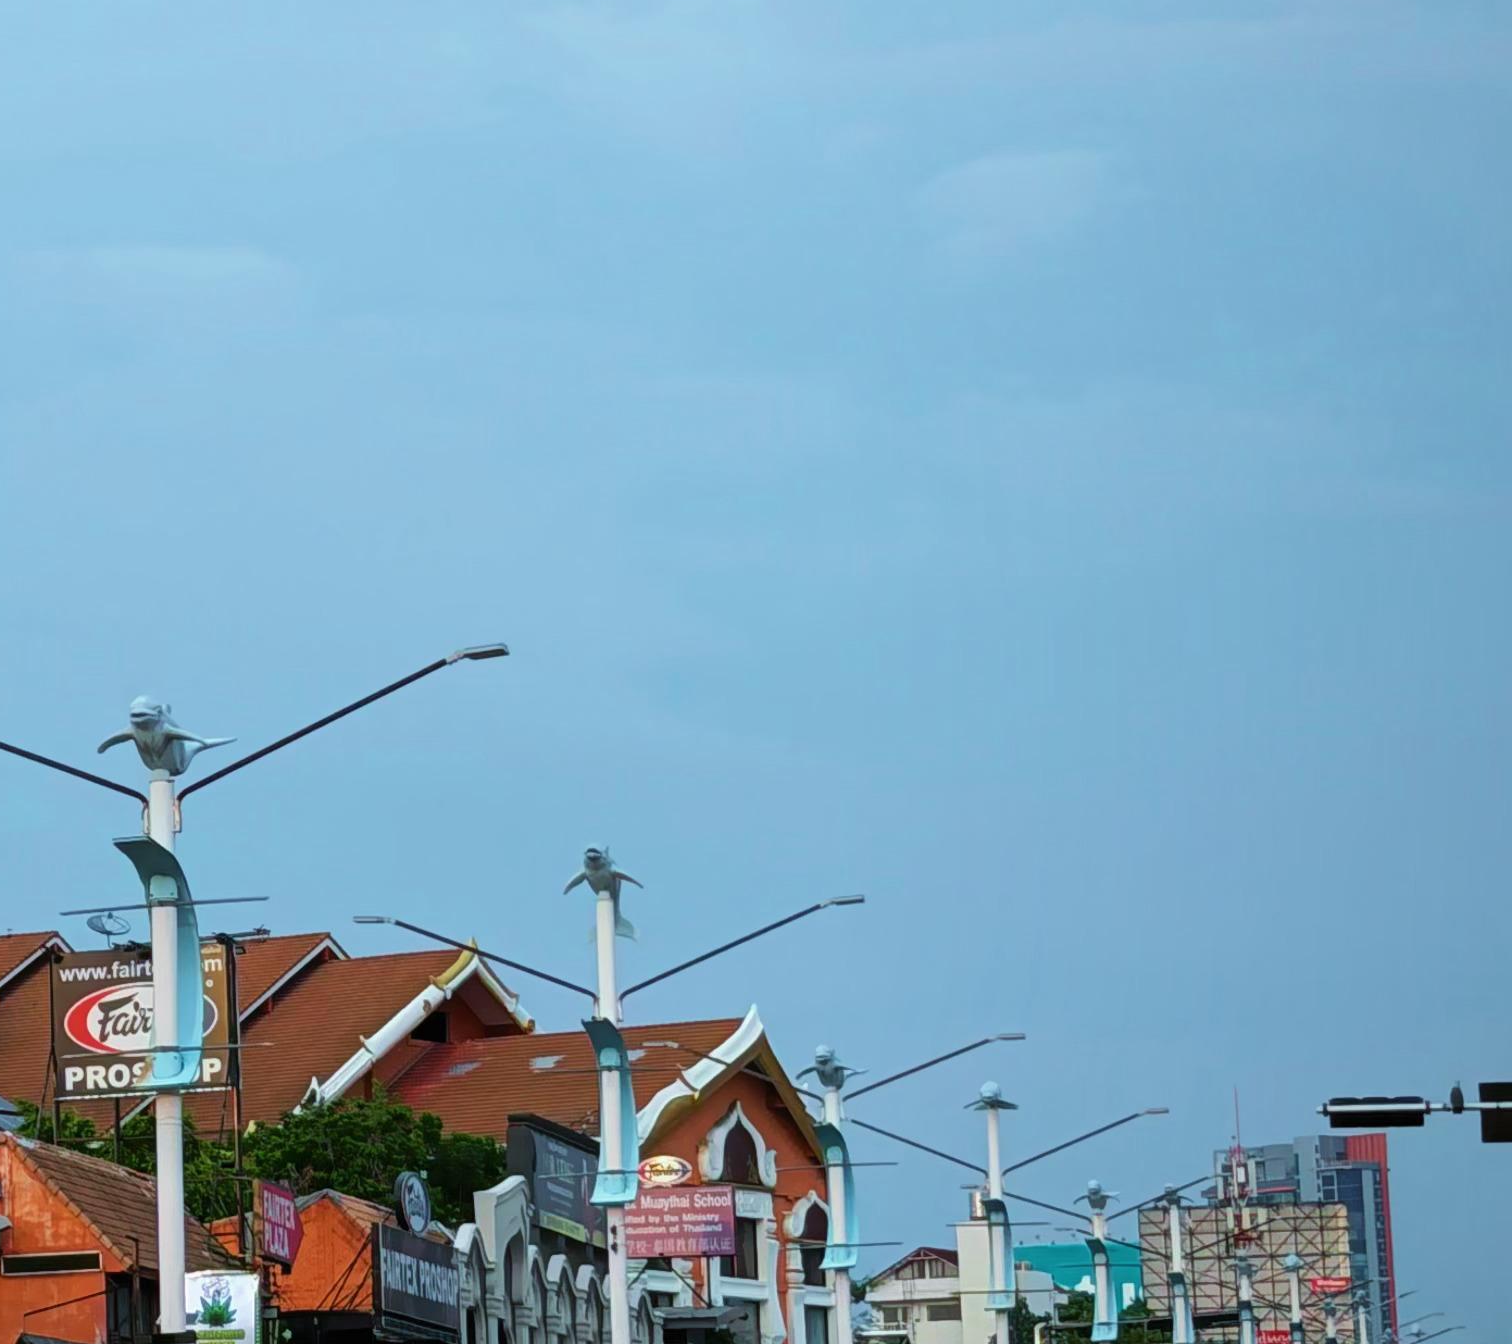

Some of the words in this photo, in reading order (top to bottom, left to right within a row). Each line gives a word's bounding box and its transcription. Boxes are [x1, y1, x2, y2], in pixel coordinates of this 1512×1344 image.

[59, 957, 223, 983] www.fairtm
[64, 1057, 222, 1091] PROSP
[263, 1189, 296, 1231] FAIRTEX
[694, 1193, 732, 1208] School
[626, 1225, 666, 1234] ducation
[683, 1223, 723, 1233] Thailand
[381, 1247, 419, 1297] FAIRTEX
[419, 1259, 457, 1309] PROSHOP
